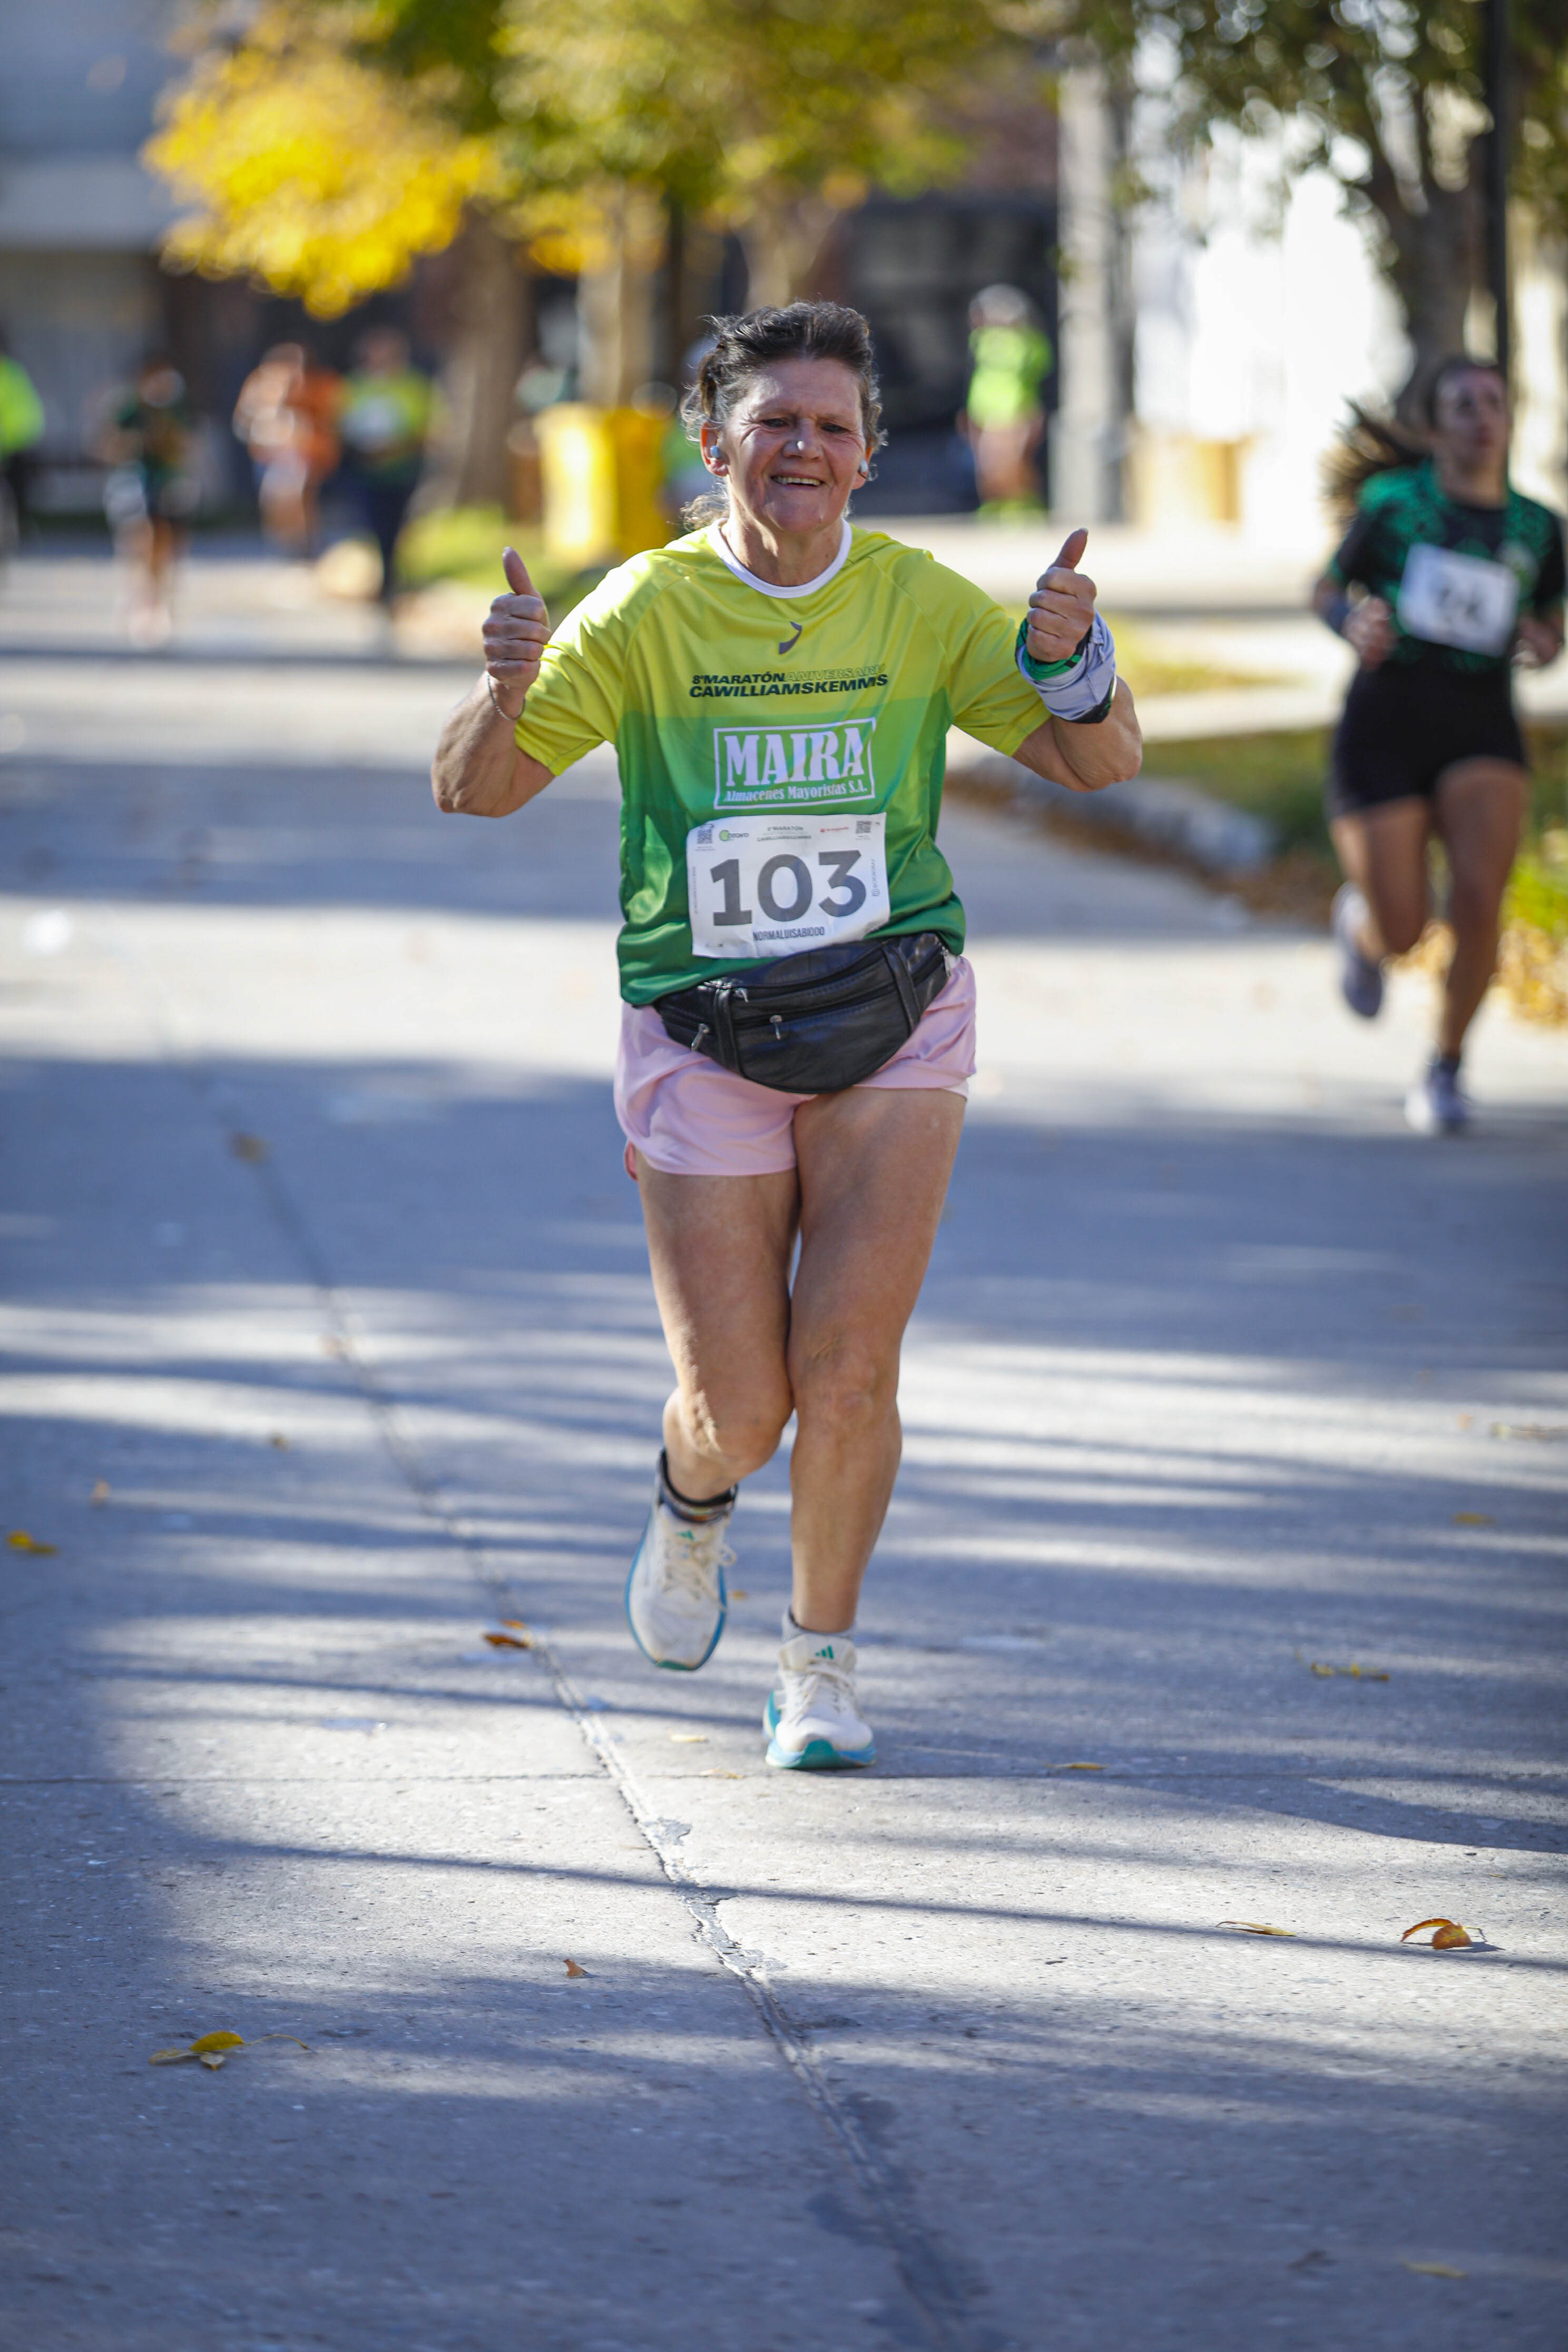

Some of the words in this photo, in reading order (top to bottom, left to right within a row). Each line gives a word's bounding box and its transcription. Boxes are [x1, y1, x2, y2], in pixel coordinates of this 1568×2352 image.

[690, 674, 888, 697] CAWILLIAMSKEMMS
[724, 728, 864, 787] MAIRA
[724, 790, 784, 801] Almacenes
[788, 783, 846, 800] Mayoristas
[848, 779, 867, 793] S.A.
[710, 850, 866, 926] 103
